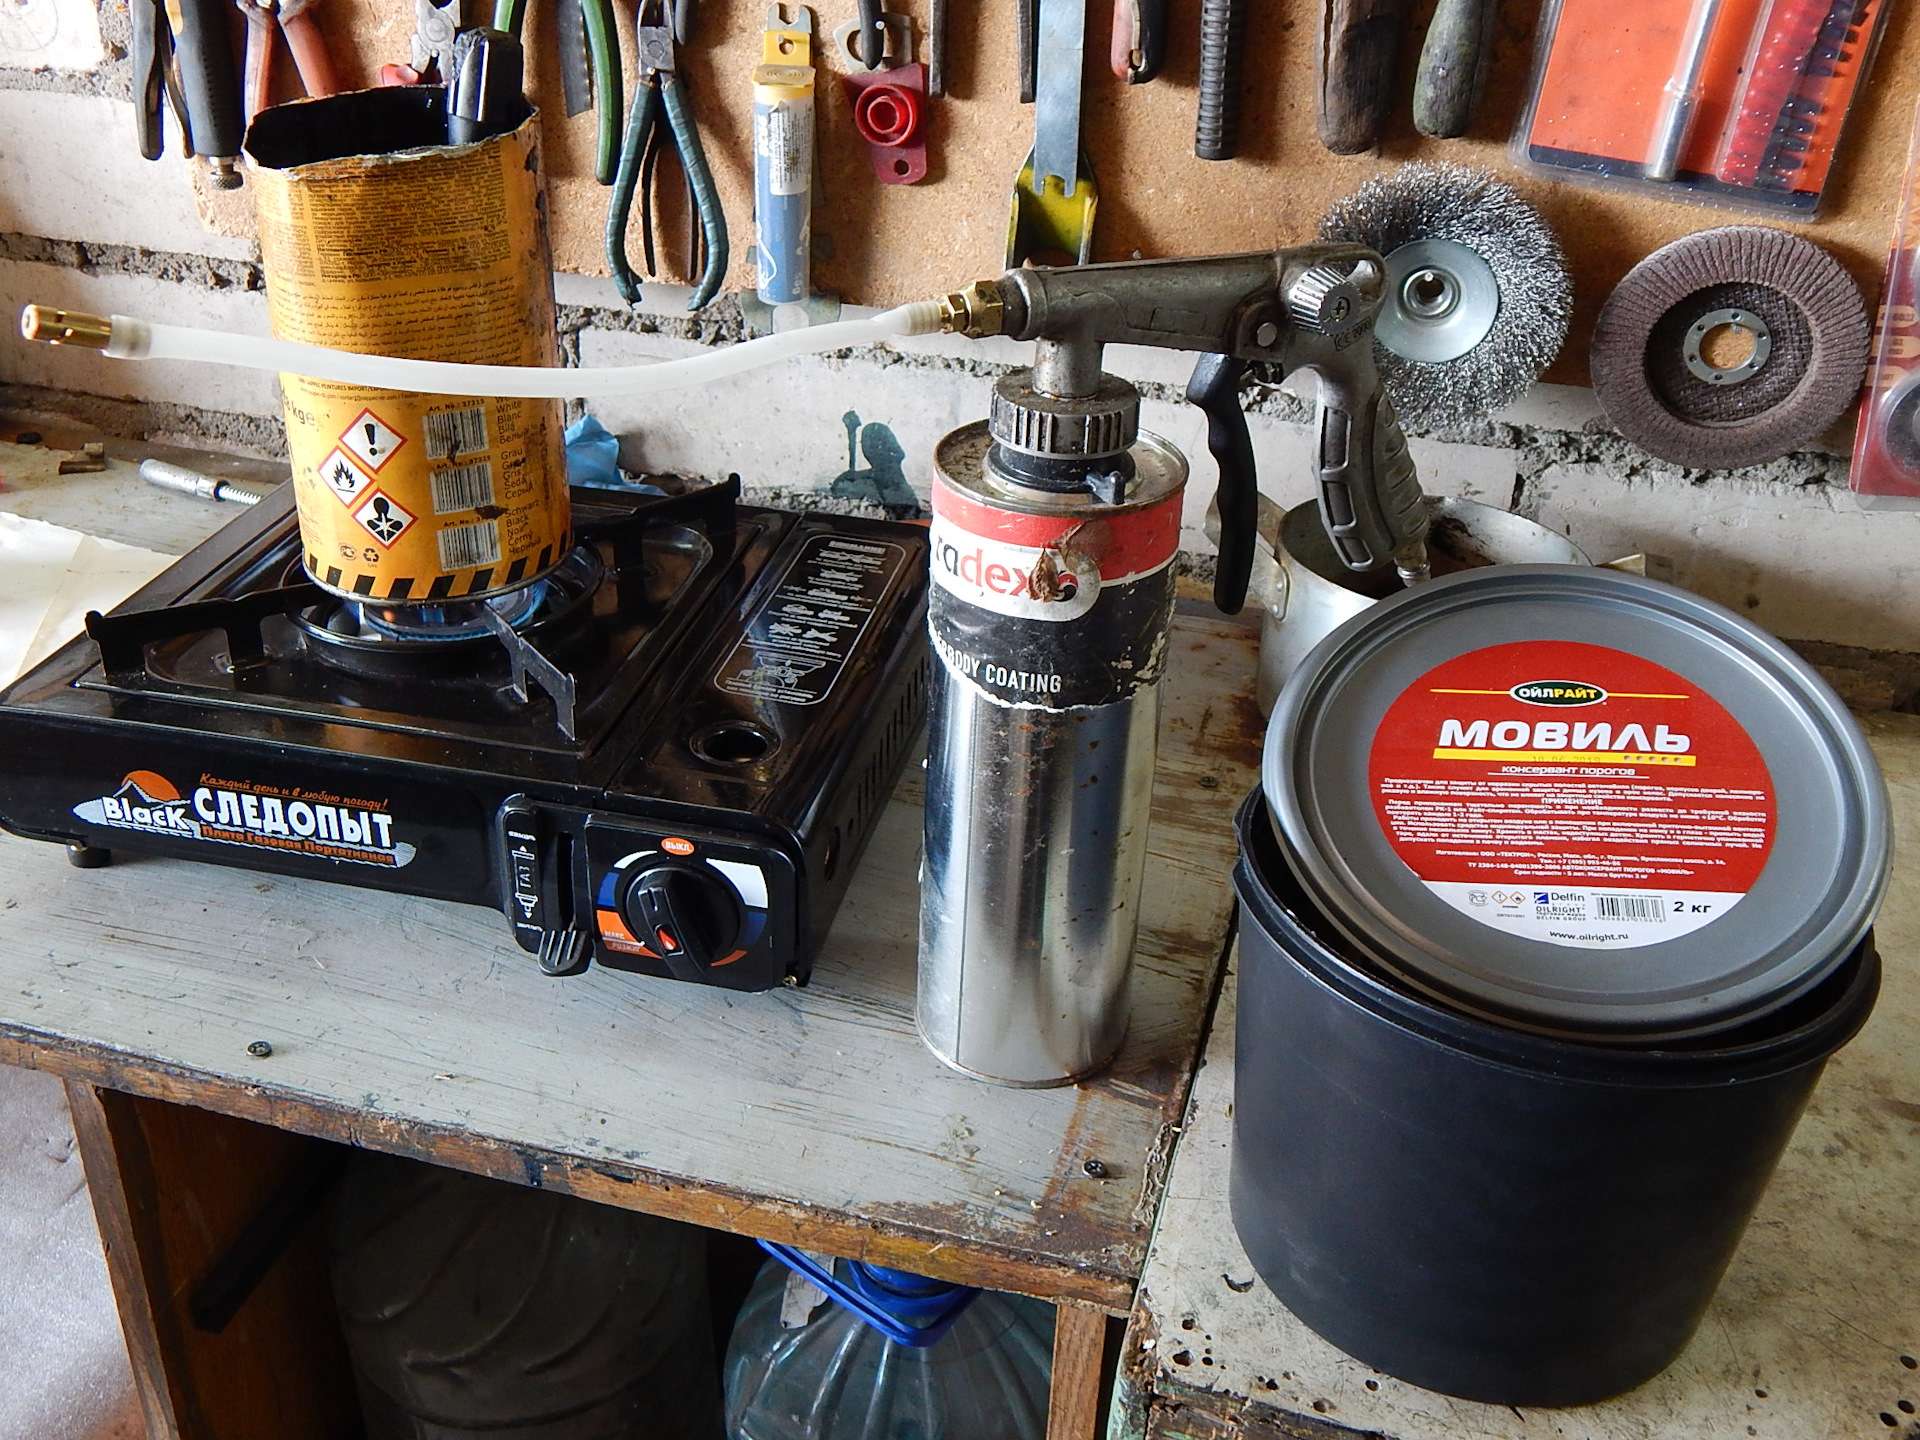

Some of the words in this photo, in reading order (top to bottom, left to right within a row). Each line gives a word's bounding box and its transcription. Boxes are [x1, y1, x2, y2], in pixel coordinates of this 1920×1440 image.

[496, 400, 522, 413] White
[498, 411, 522, 424] Blanc
[501, 447, 523, 460] Grau
[985, 664, 1062, 693] COATING
[1518, 687, 1598, 699] ОЙЛРАЙТ
[1438, 719, 1691, 753] МОВИЛЬ
[1502, 766, 1578, 775] консервант
[1580, 767, 1636, 776] порогов
[200, 773, 250, 791] Каждый
[253, 783, 279, 796] день
[302, 790, 340, 805] любую
[343, 796, 389, 813] погоду!
[194, 787, 392, 848] СЛЕДОПЫТ
[1551, 892, 1585, 902] Delfin
[1673, 901, 1684, 912] 2
[1691, 905, 1711, 914] кг
[1549, 931, 1628, 942] www.oilright.ru
